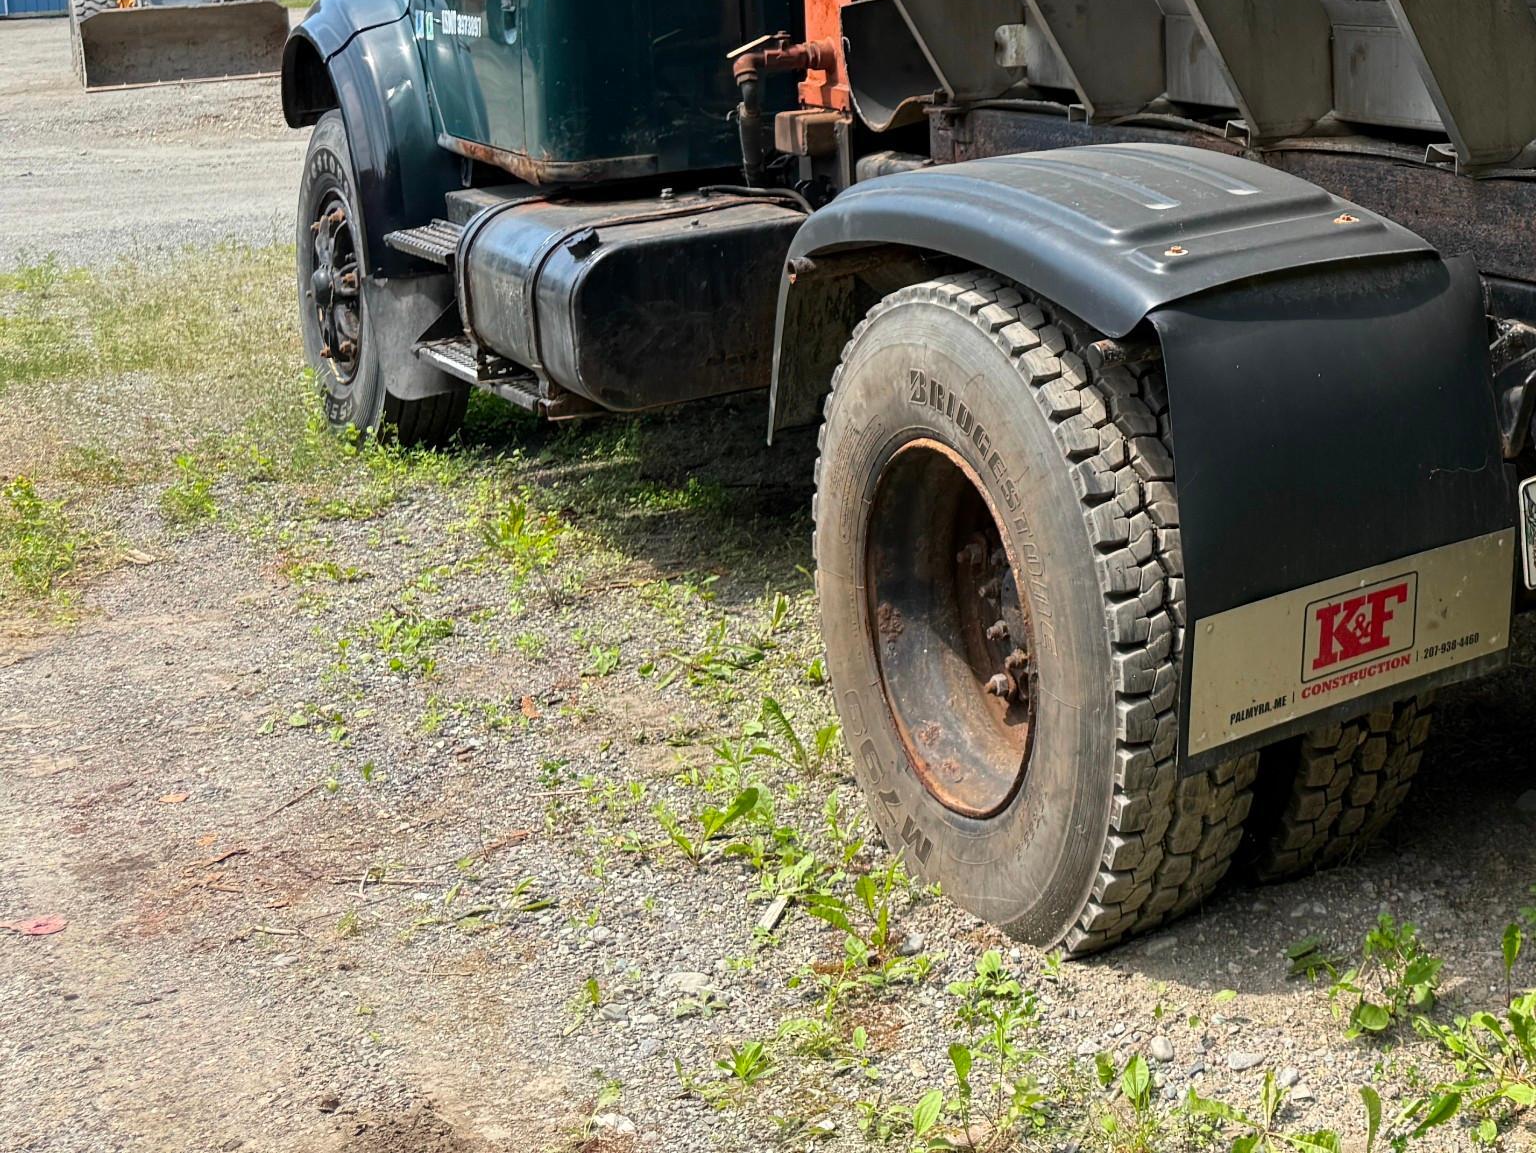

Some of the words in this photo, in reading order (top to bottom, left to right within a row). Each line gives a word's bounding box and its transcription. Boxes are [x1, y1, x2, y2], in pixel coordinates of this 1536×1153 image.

[908, 367, 1058, 658] BRIDGESTONE
[1273, 695, 1287, 710] ME
[1301, 653, 1412, 700] CONSTRUCTION
[1423, 632, 1480, 660] 207-938-4460
[1312, 582, 1408, 671] K&F
